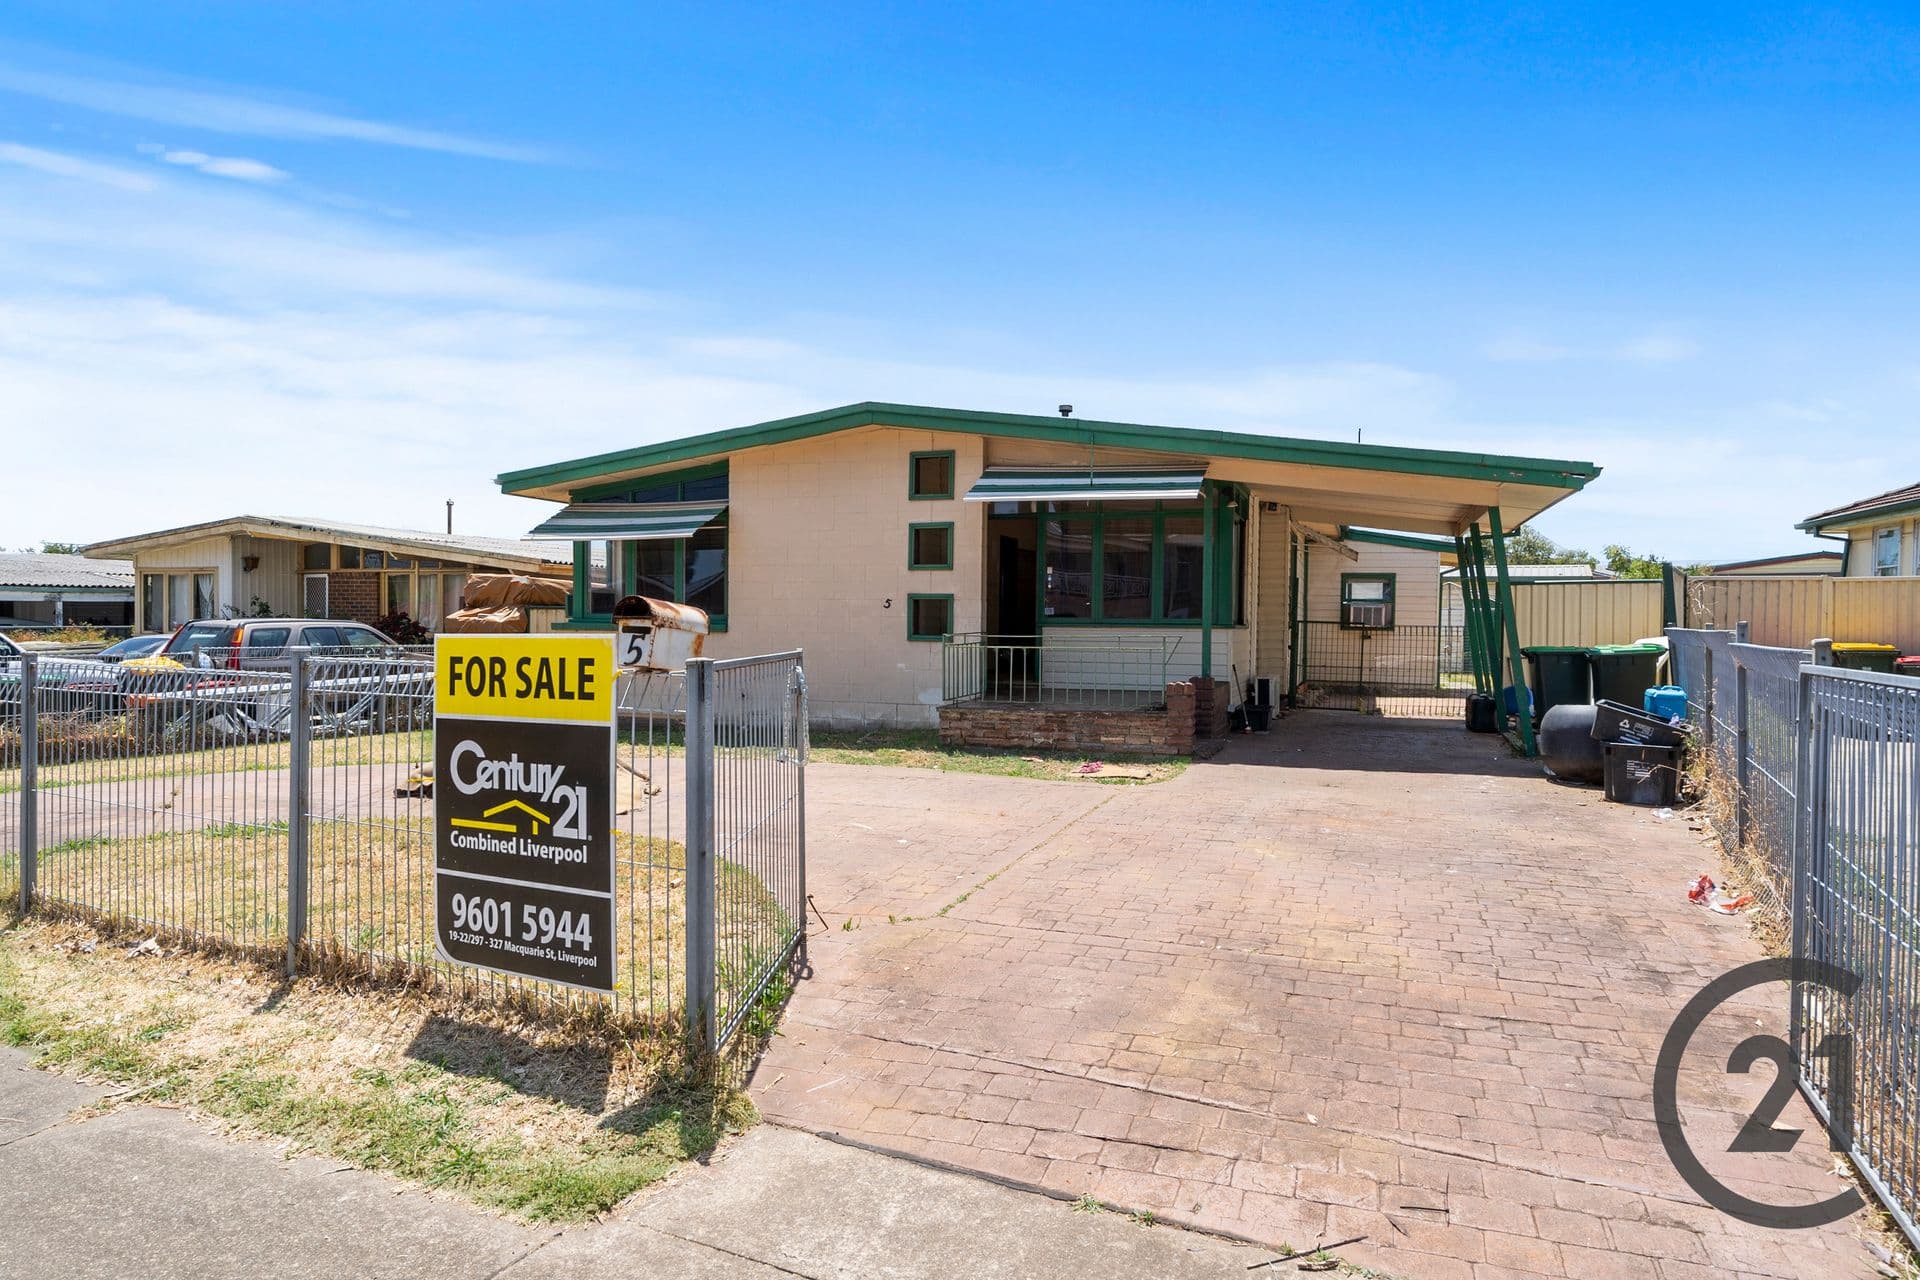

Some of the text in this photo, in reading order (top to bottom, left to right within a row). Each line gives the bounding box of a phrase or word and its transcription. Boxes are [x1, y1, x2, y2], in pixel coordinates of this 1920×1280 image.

[883, 598, 893, 609] 5
[623, 633, 647, 666] 5
[449, 656, 596, 700] FOR SALE
[450, 740, 587, 840] Century 21
[450, 831, 588, 864] Combined Liverpool
[452, 893, 593, 951] 9601 5944
[448, 930, 484, 946] 19-22/297
[489, 938, 503, 950] 327
[504, 940, 545, 957] Macquarie
[545, 948, 557, 962] St,
[558, 951, 598, 968] Liverpool
